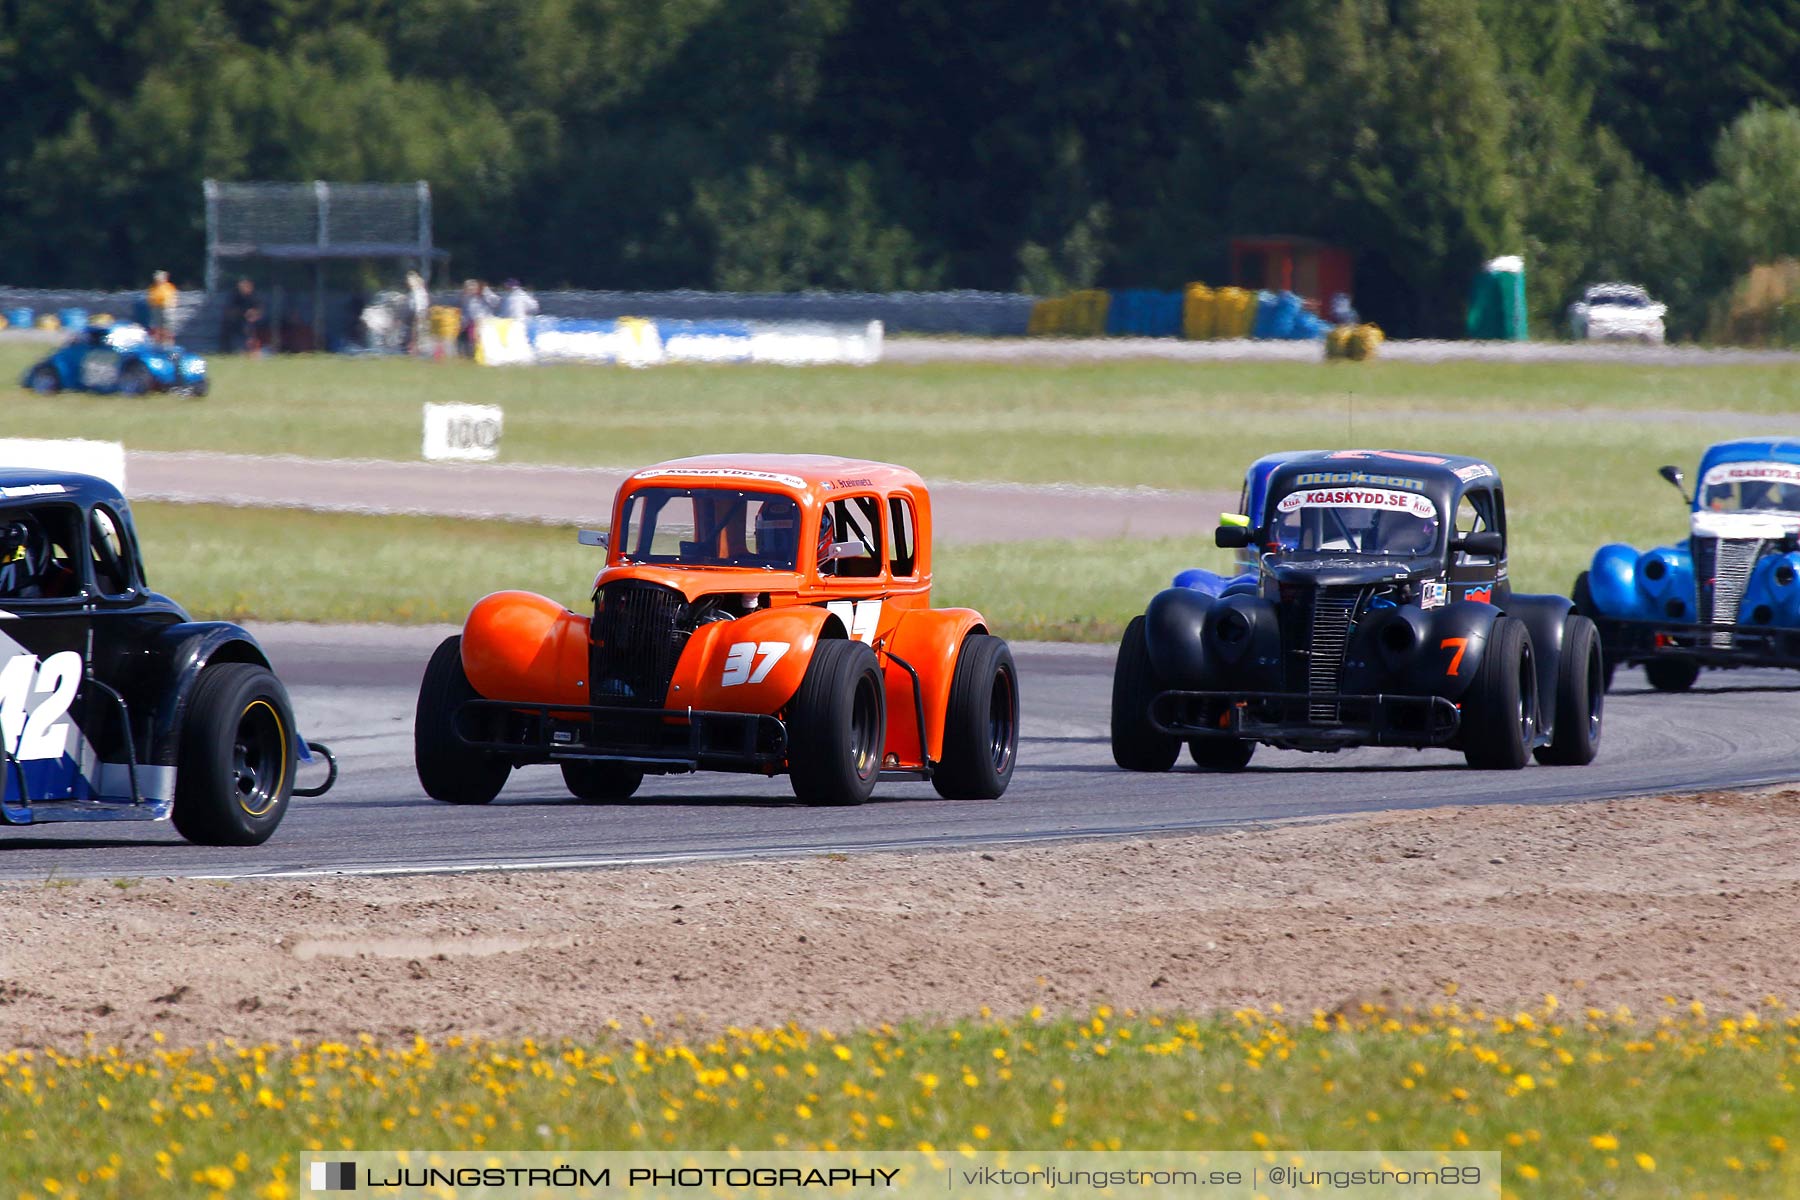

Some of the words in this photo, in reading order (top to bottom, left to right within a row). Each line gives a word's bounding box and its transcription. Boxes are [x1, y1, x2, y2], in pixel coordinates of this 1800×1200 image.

[1305, 491, 1408, 507] KGASKYDD.SE
[721, 641, 791, 687] 37
[1440, 637, 1469, 676] 7
